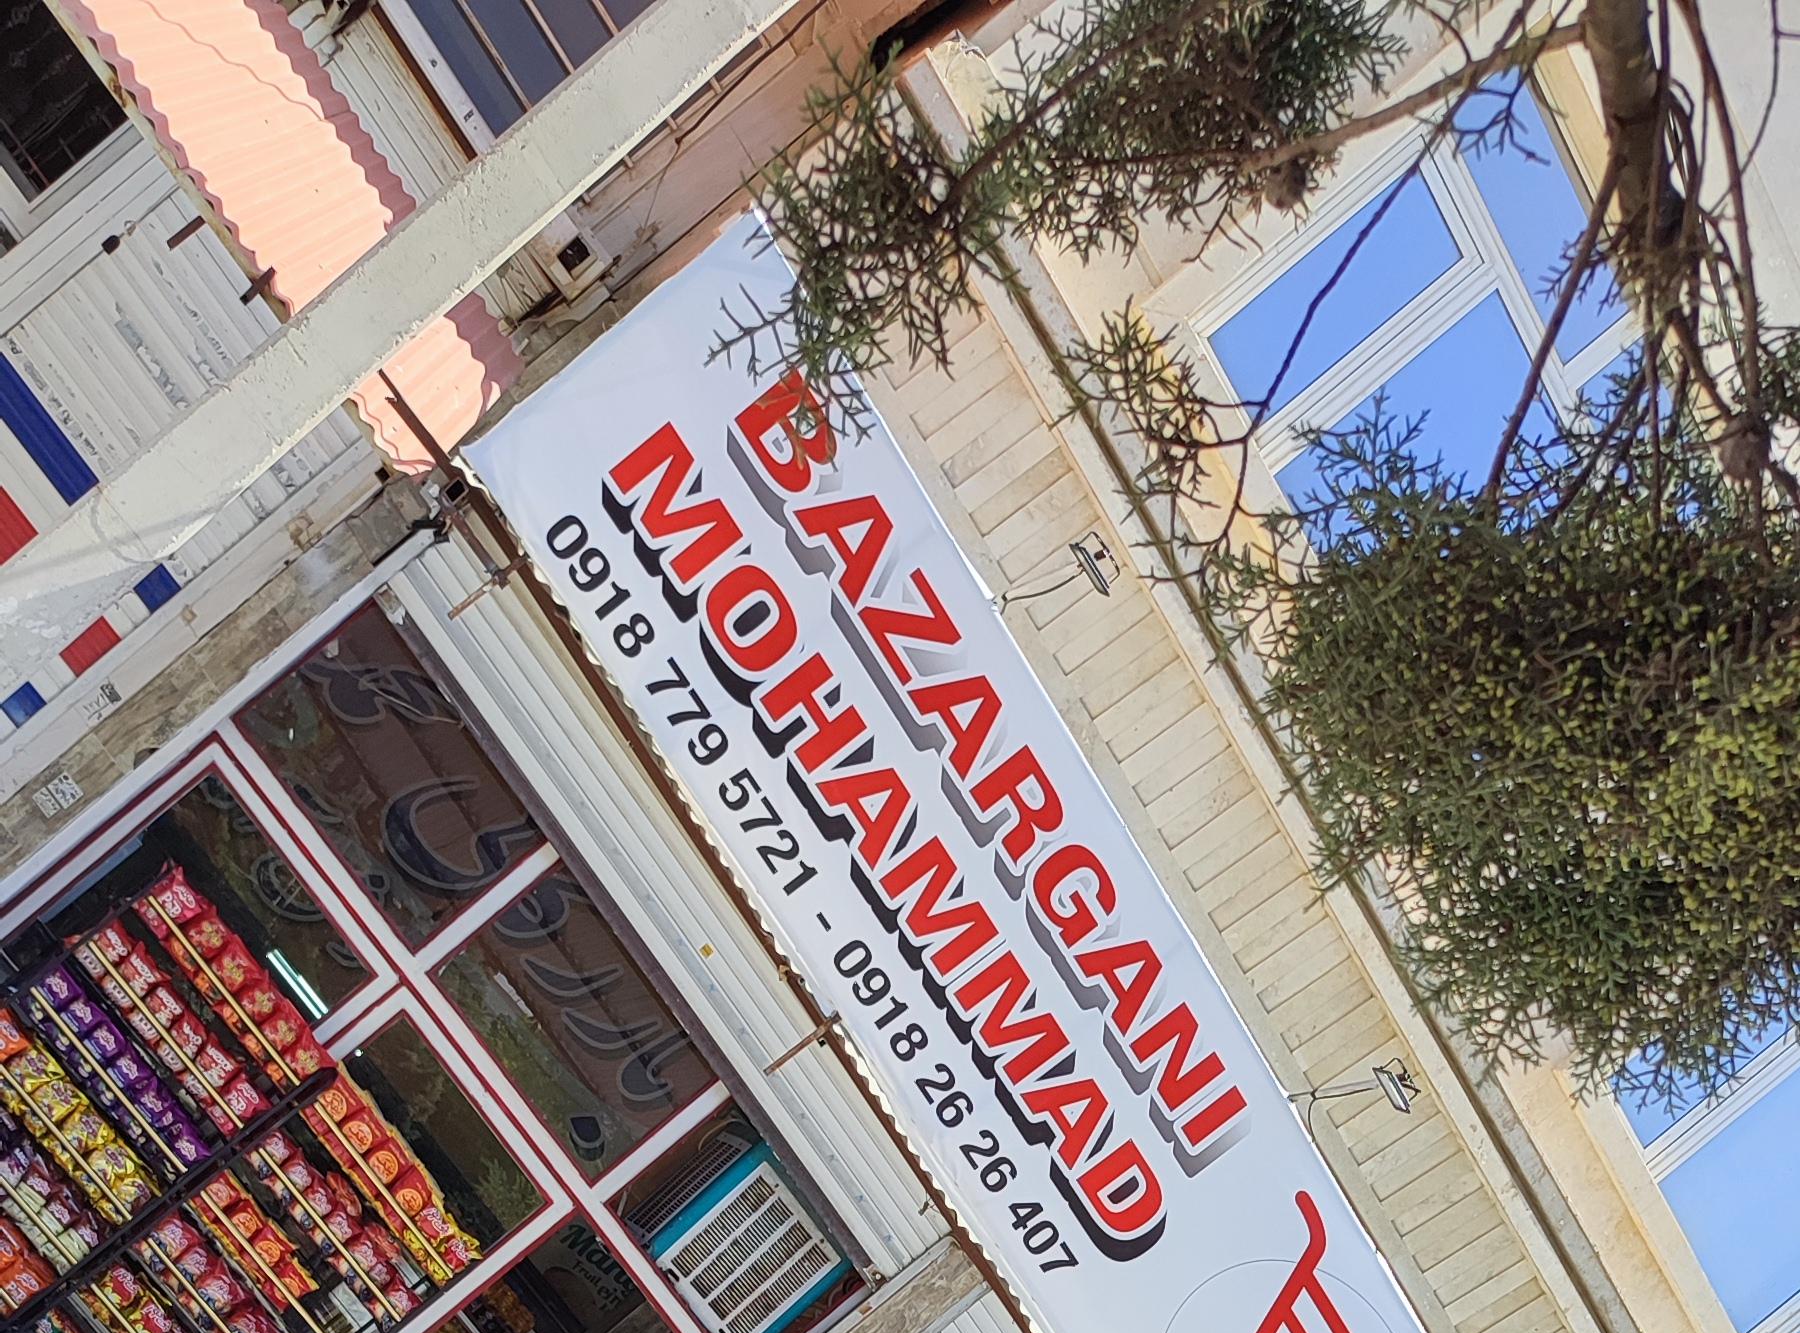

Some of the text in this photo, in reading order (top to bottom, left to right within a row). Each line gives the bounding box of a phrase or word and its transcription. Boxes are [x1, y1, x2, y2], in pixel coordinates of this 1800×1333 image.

[544, 513, 656, 660] 0918
[645, 655, 731, 767] 779
[717, 766, 820, 897] 5721
[832, 938, 931, 1064] 0918
[914, 1062, 976, 1130] 26
[957, 1128, 1020, 1195] 26
[1007, 1201, 1081, 1275] 407
[609, 421, 1166, 1236] MOHAMMAD
[733, 366, 1249, 1149] BAZARGANI
